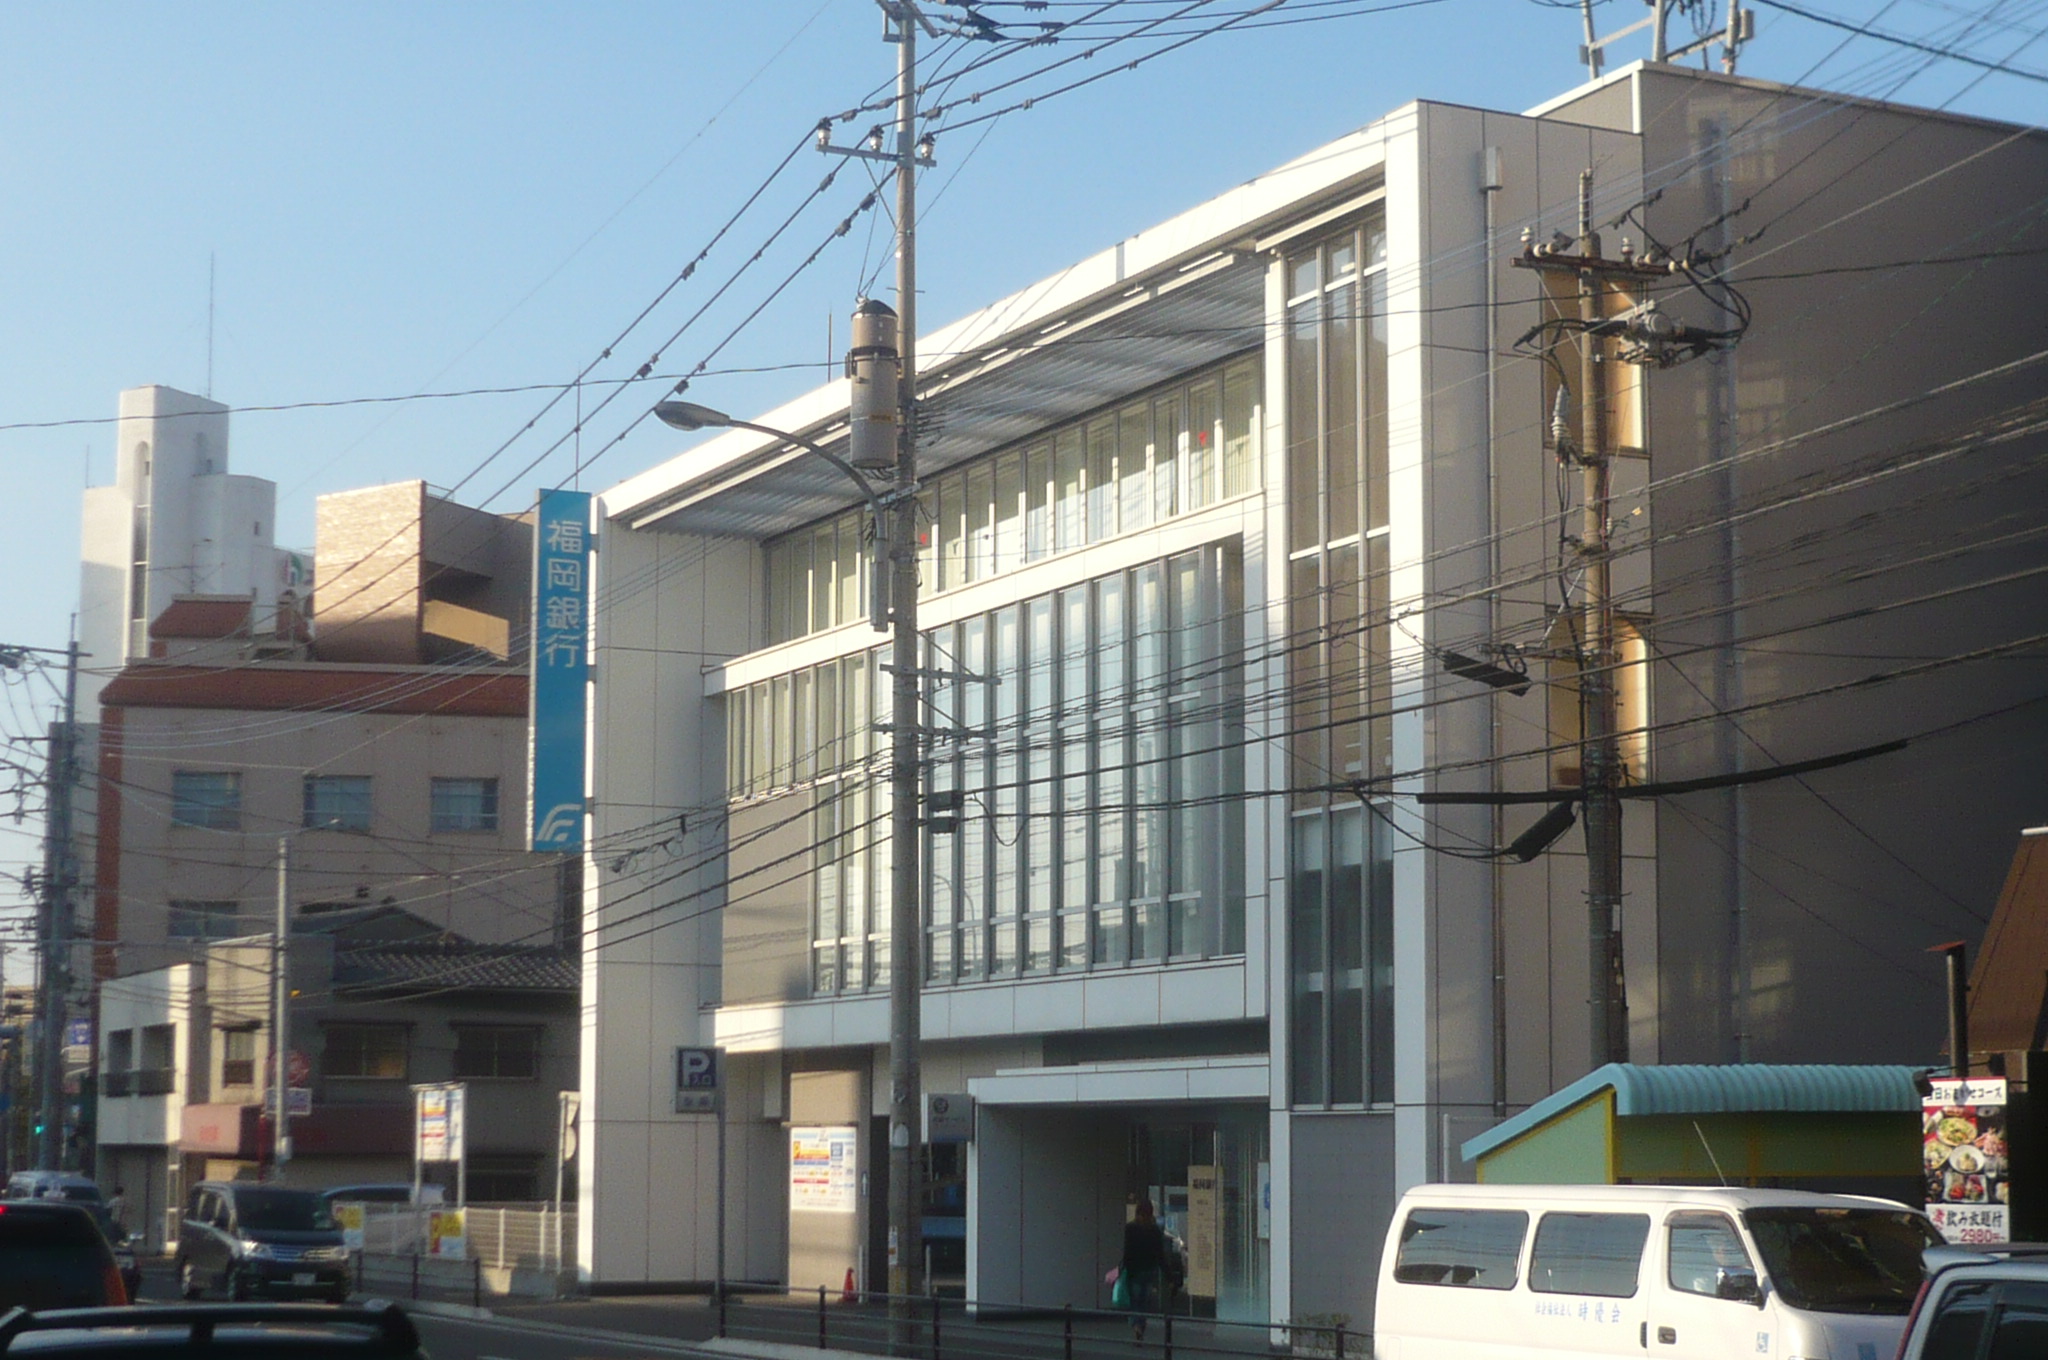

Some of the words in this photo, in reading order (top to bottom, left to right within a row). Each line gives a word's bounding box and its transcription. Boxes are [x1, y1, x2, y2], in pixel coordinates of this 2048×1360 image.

[545, 520, 583, 668] 福岡銀行
[682, 1051, 710, 1088] P
[1946, 1210, 2003, 1228] 飲み放題付
